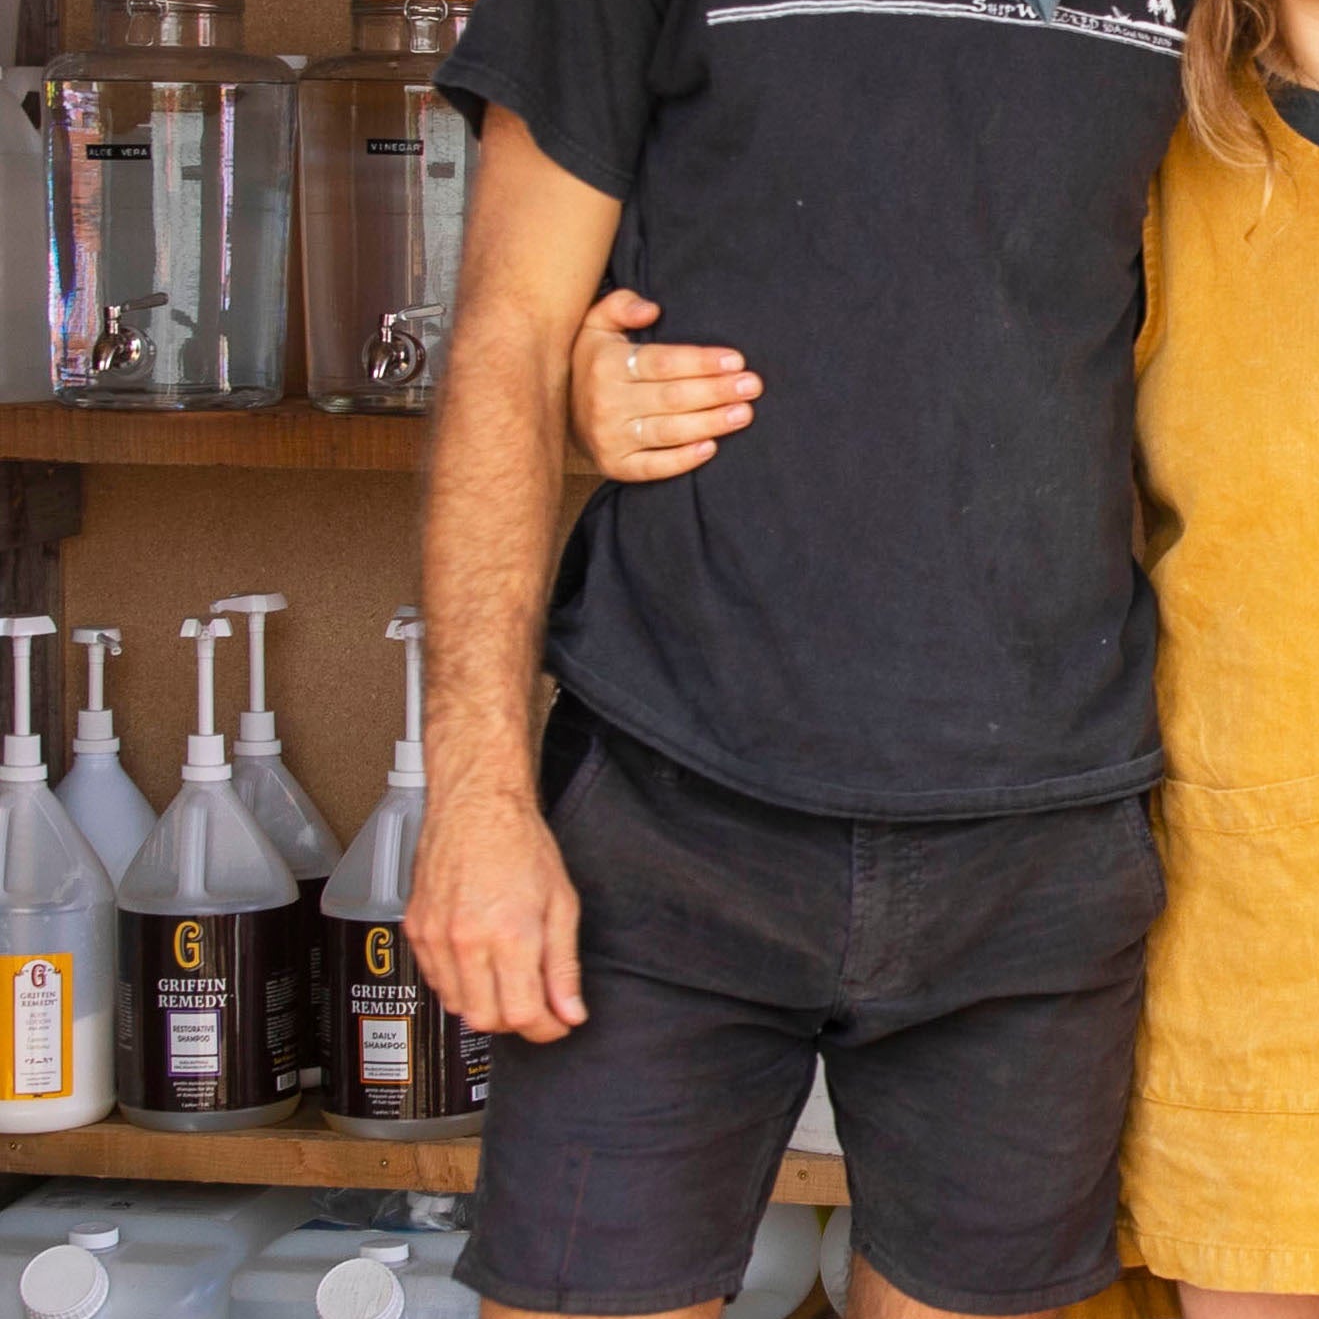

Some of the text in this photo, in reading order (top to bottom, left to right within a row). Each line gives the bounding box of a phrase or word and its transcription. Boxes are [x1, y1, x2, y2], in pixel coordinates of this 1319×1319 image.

[121, 148, 147, 156] VERA
[370, 142, 421, 152] VINEGAR
[173, 920, 204, 973] G
[365, 926, 395, 978] G
[31, 964, 47, 988] G
[158, 978, 227, 993] GRIFFIN
[20, 991, 56, 1000] GRIFFIN
[351, 984, 417, 999] GRIFFIN
[21, 999, 55, 1008] REMEDY
[158, 994, 229, 1008] REMEDY
[351, 1000, 418, 1015] REMEDY
[172, 1025, 215, 1033] RESTORATIVE
[177, 1035, 211, 1043] SHAMPOO
[372, 1032, 396, 1040] DAILY
[364, 1041, 406, 1050] SHAMPOO
